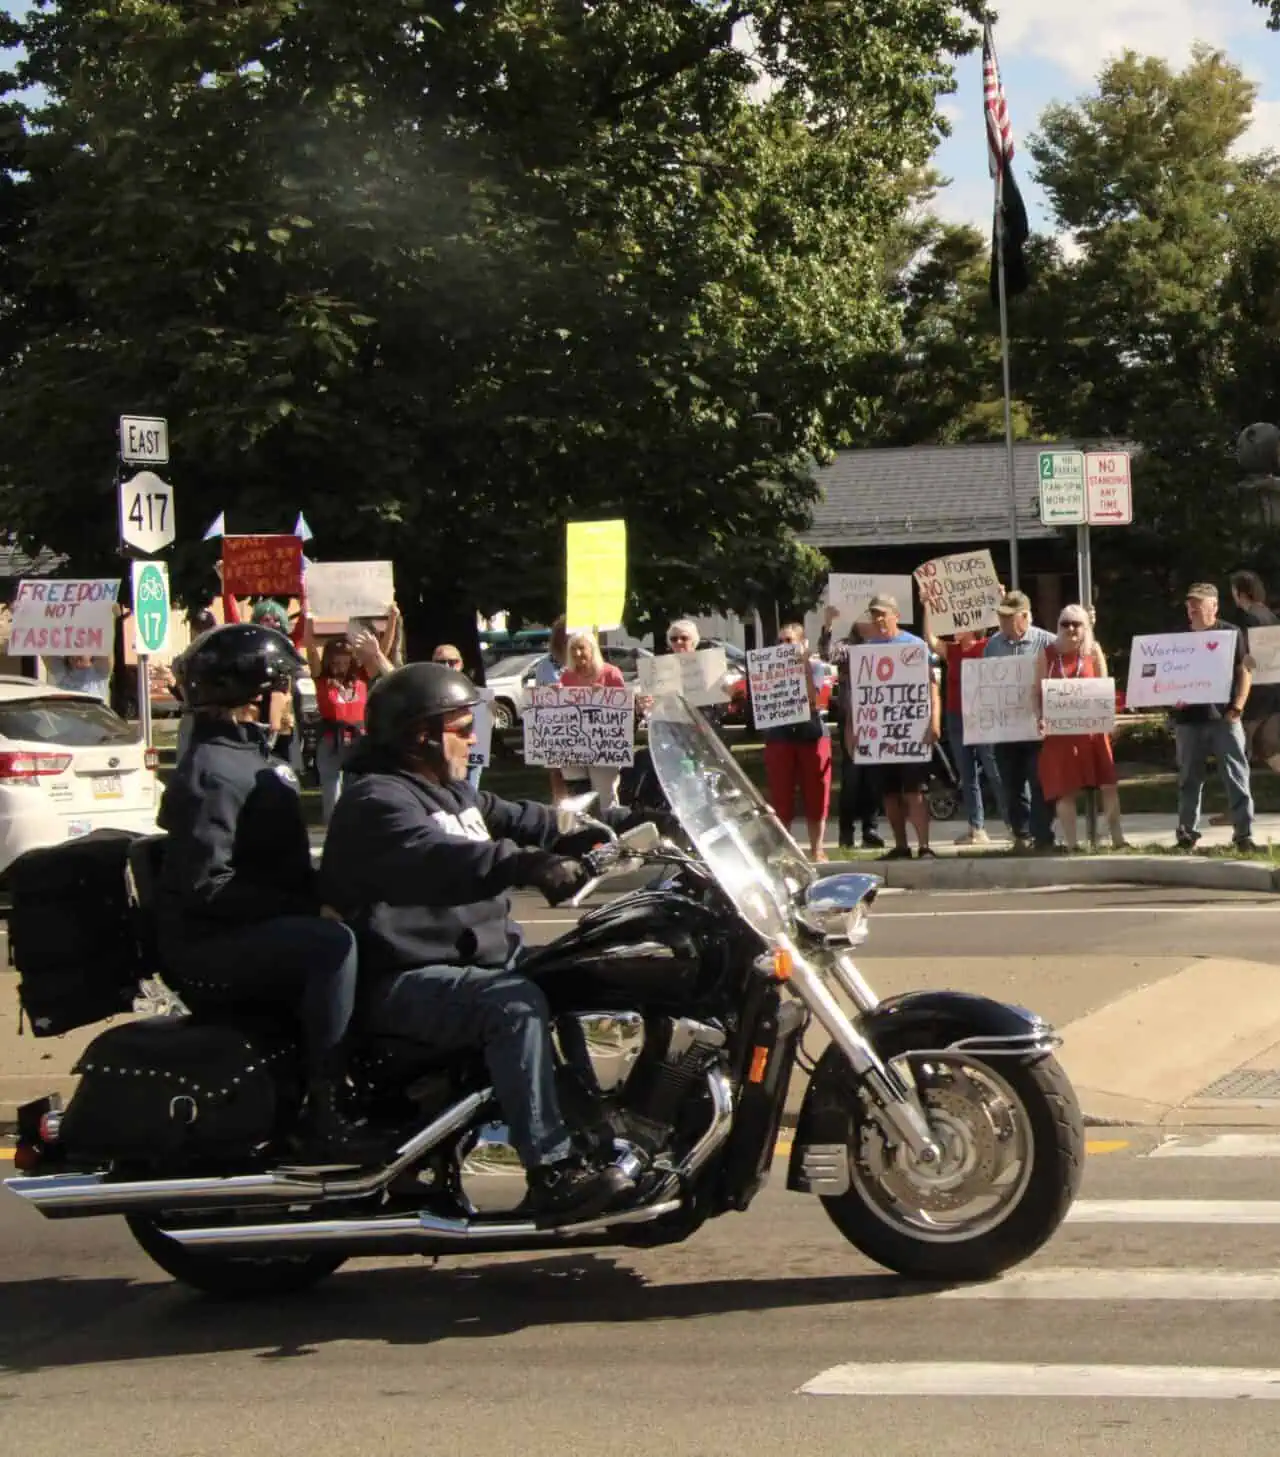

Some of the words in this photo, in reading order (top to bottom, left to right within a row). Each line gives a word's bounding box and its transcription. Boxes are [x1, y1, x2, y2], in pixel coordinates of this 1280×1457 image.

[128, 425, 161, 454] EAST
[1042, 457, 1051, 476] 2
[1098, 460, 1116, 473] NO
[128, 492, 169, 532] 417
[915, 562, 937, 578] NO
[943, 558, 986, 576] Troops
[17, 582, 119, 603] FREEDOM
[923, 578, 944, 598] NO
[44, 603, 80, 619] NOT
[928, 595, 948, 616] NO
[10, 623, 105, 649] FASCISM
[144, 612, 162, 641] 17
[751, 651, 772, 662] Dear
[856, 654, 895, 685] NO
[563, 687, 594, 705] SAY
[600, 687, 628, 705] NO
[582, 708, 628, 725] TRUMP
[856, 704, 878, 723] NO
[591, 726, 626, 738] MUSK
[856, 725, 878, 741] NO
[881, 722, 913, 740] ICE
[467, 752, 485, 765] ES
